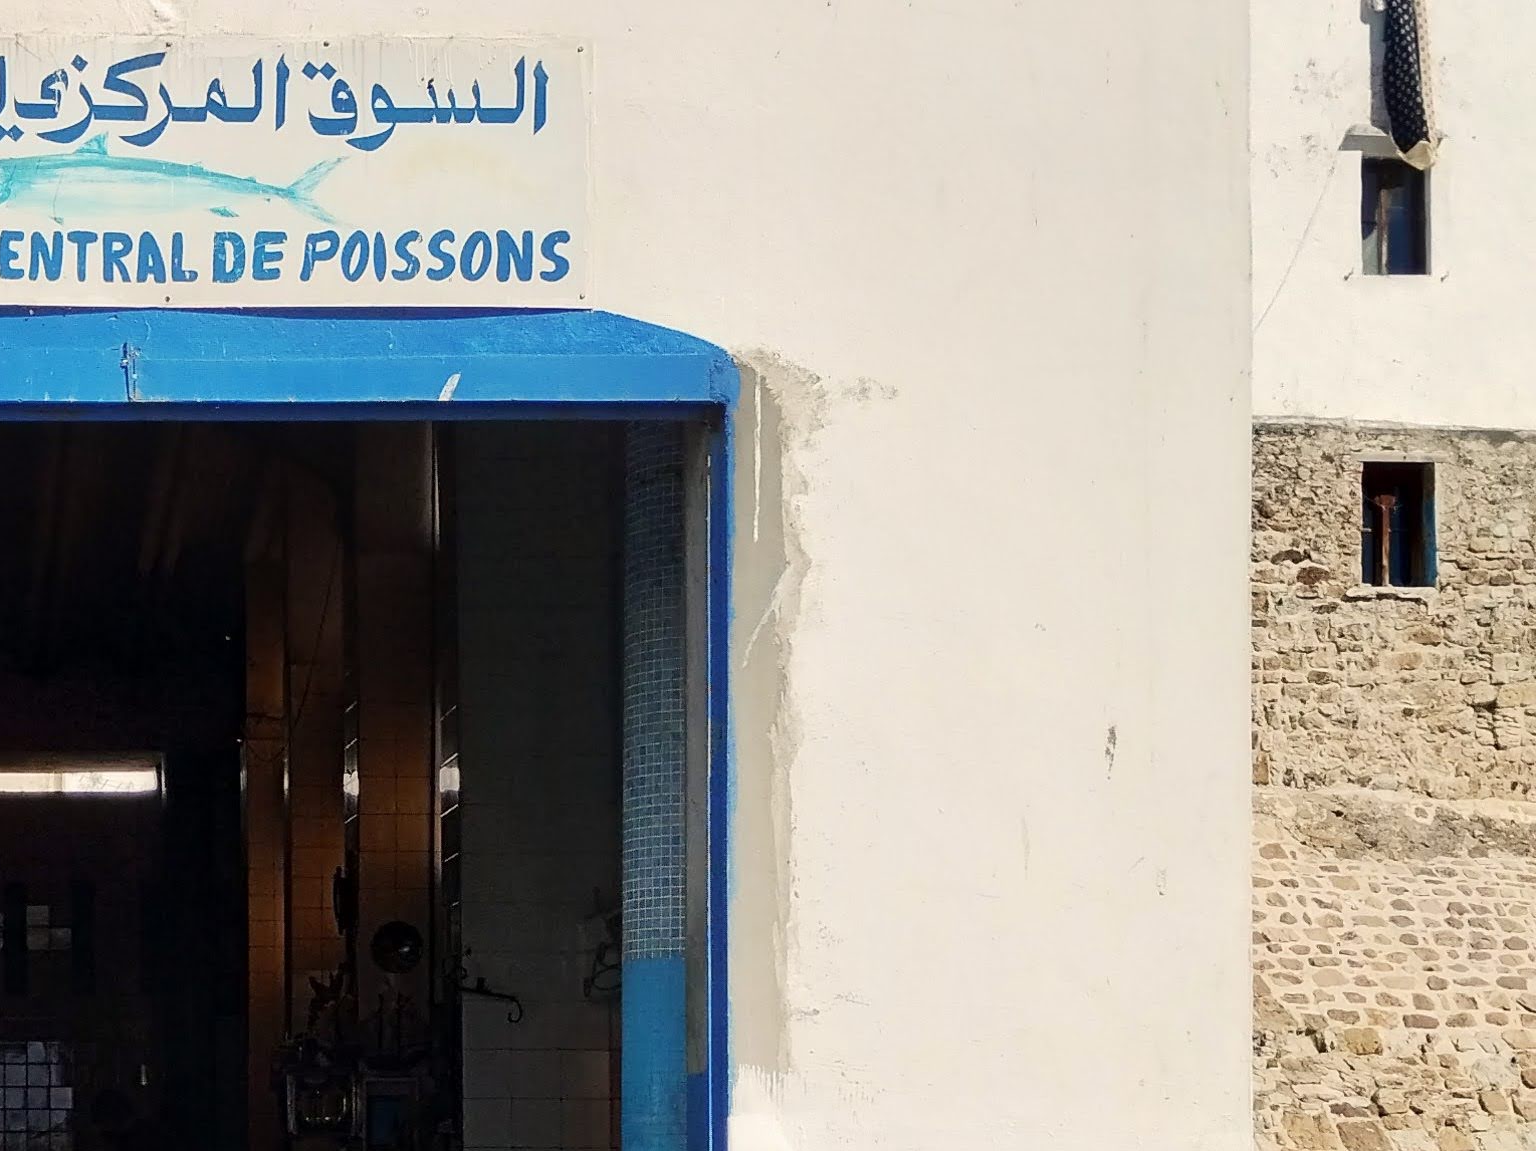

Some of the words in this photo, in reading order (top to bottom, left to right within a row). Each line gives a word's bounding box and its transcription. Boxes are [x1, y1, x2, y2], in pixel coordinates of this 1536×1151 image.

[304, 60, 548, 152] السوق
[212, 231, 288, 283] DE
[299, 229, 571, 283] POISSONS
